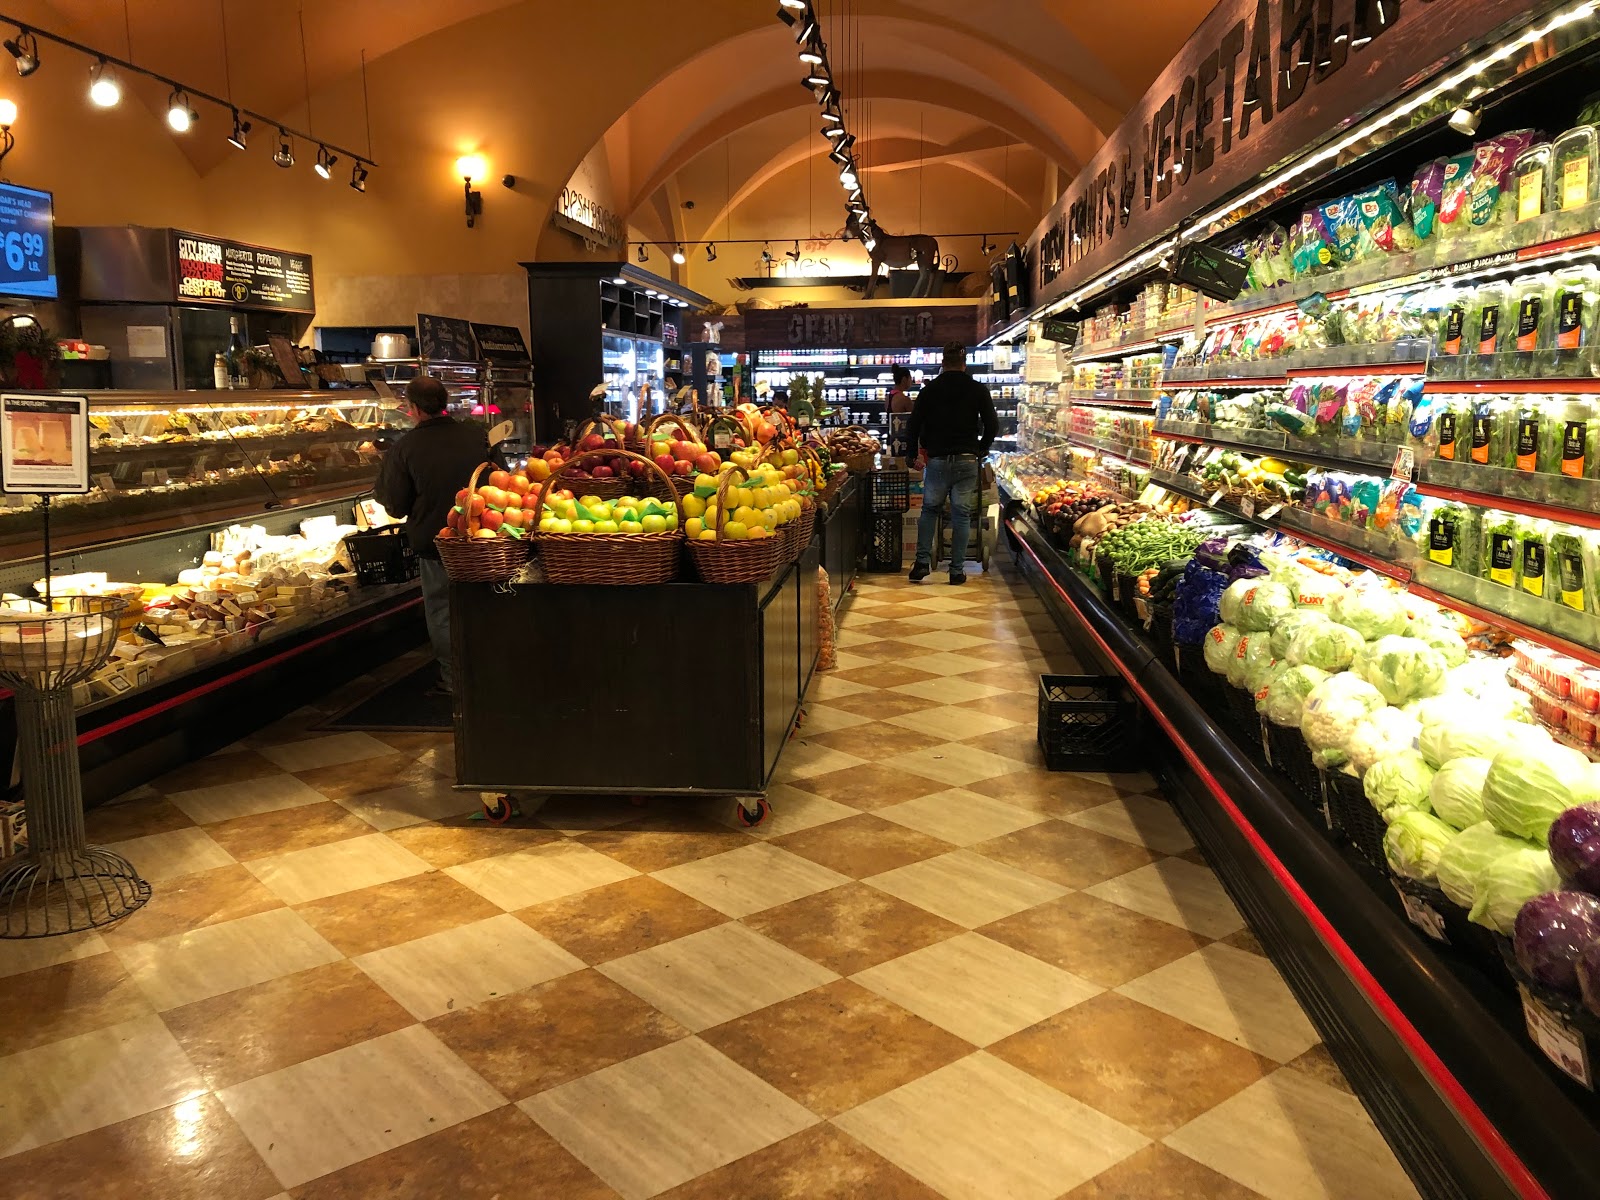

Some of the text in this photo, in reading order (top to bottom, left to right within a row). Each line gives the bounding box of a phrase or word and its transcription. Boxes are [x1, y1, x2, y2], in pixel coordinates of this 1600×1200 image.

[1143, 0, 1402, 211] VEGETABL
[178, 239, 197, 254] CITY
[197, 241, 222, 257] FRESH
[179, 250, 223, 264] MARKET
[179, 283, 227, 298] FRESH & HOT
[183, 277, 222, 290] ORDER
[787, 313, 855, 344] GRAB
[899, 311, 936, 344] GO
[1298, 594, 1325, 605] FOXY
